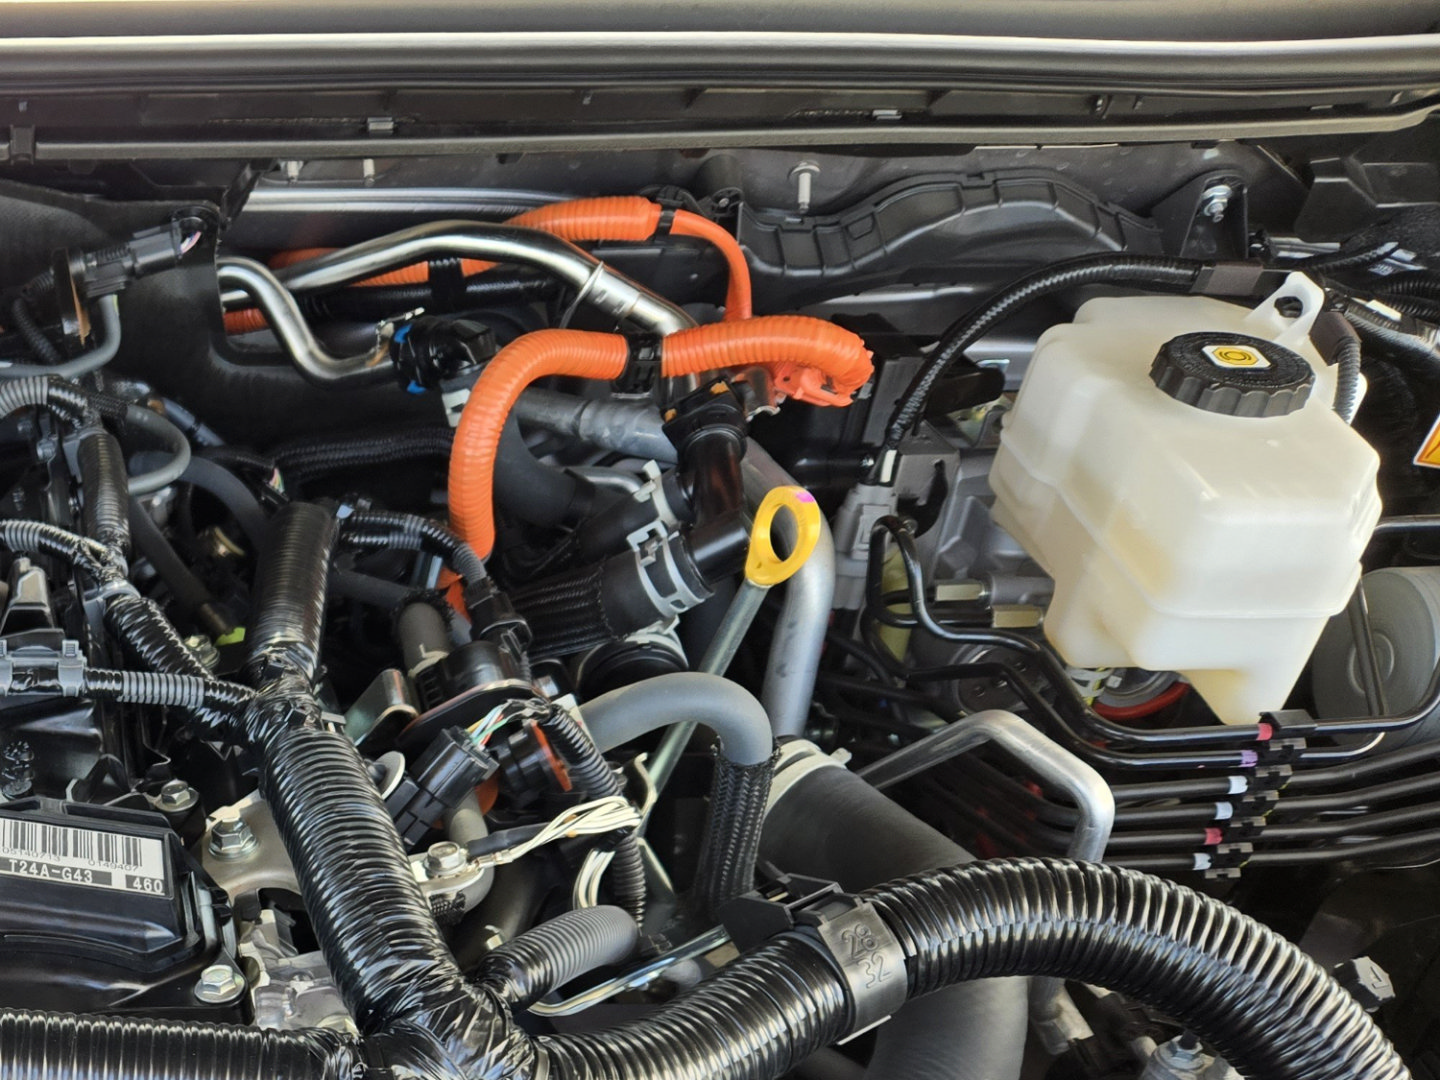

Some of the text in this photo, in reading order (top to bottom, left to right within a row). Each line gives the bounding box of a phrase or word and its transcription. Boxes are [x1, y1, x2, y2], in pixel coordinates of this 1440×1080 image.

[8, 859, 93, 884] T24A-G43
[132, 877, 163, 894] 460
[841, 923, 879, 961] 28
[857, 951, 892, 988] 32
